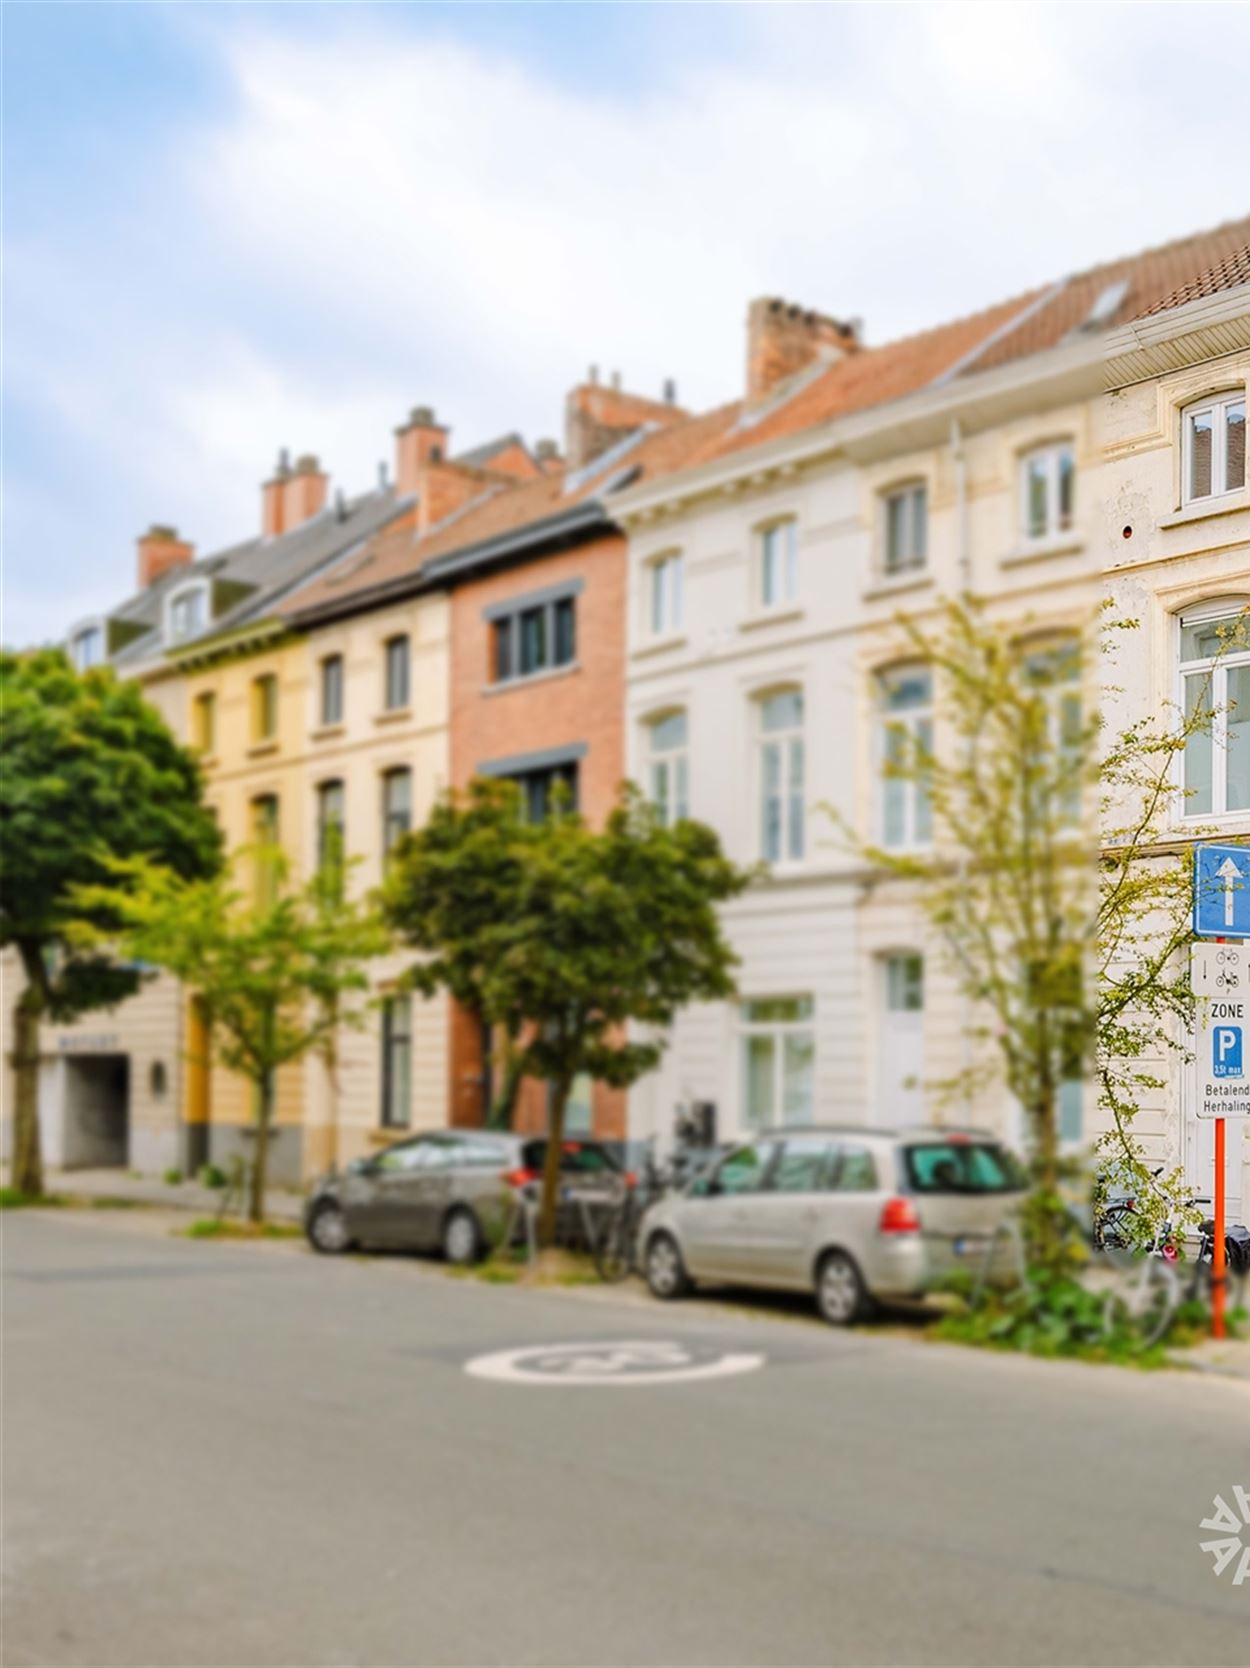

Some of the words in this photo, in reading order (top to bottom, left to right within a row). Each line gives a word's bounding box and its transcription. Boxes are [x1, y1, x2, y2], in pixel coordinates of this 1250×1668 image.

[1211, 1003, 1244, 1018] ZONE
[1219, 1030, 1237, 1062] P
[1228, 1066, 1241, 1074] max
[1205, 1084, 1250, 1097] Betalend
